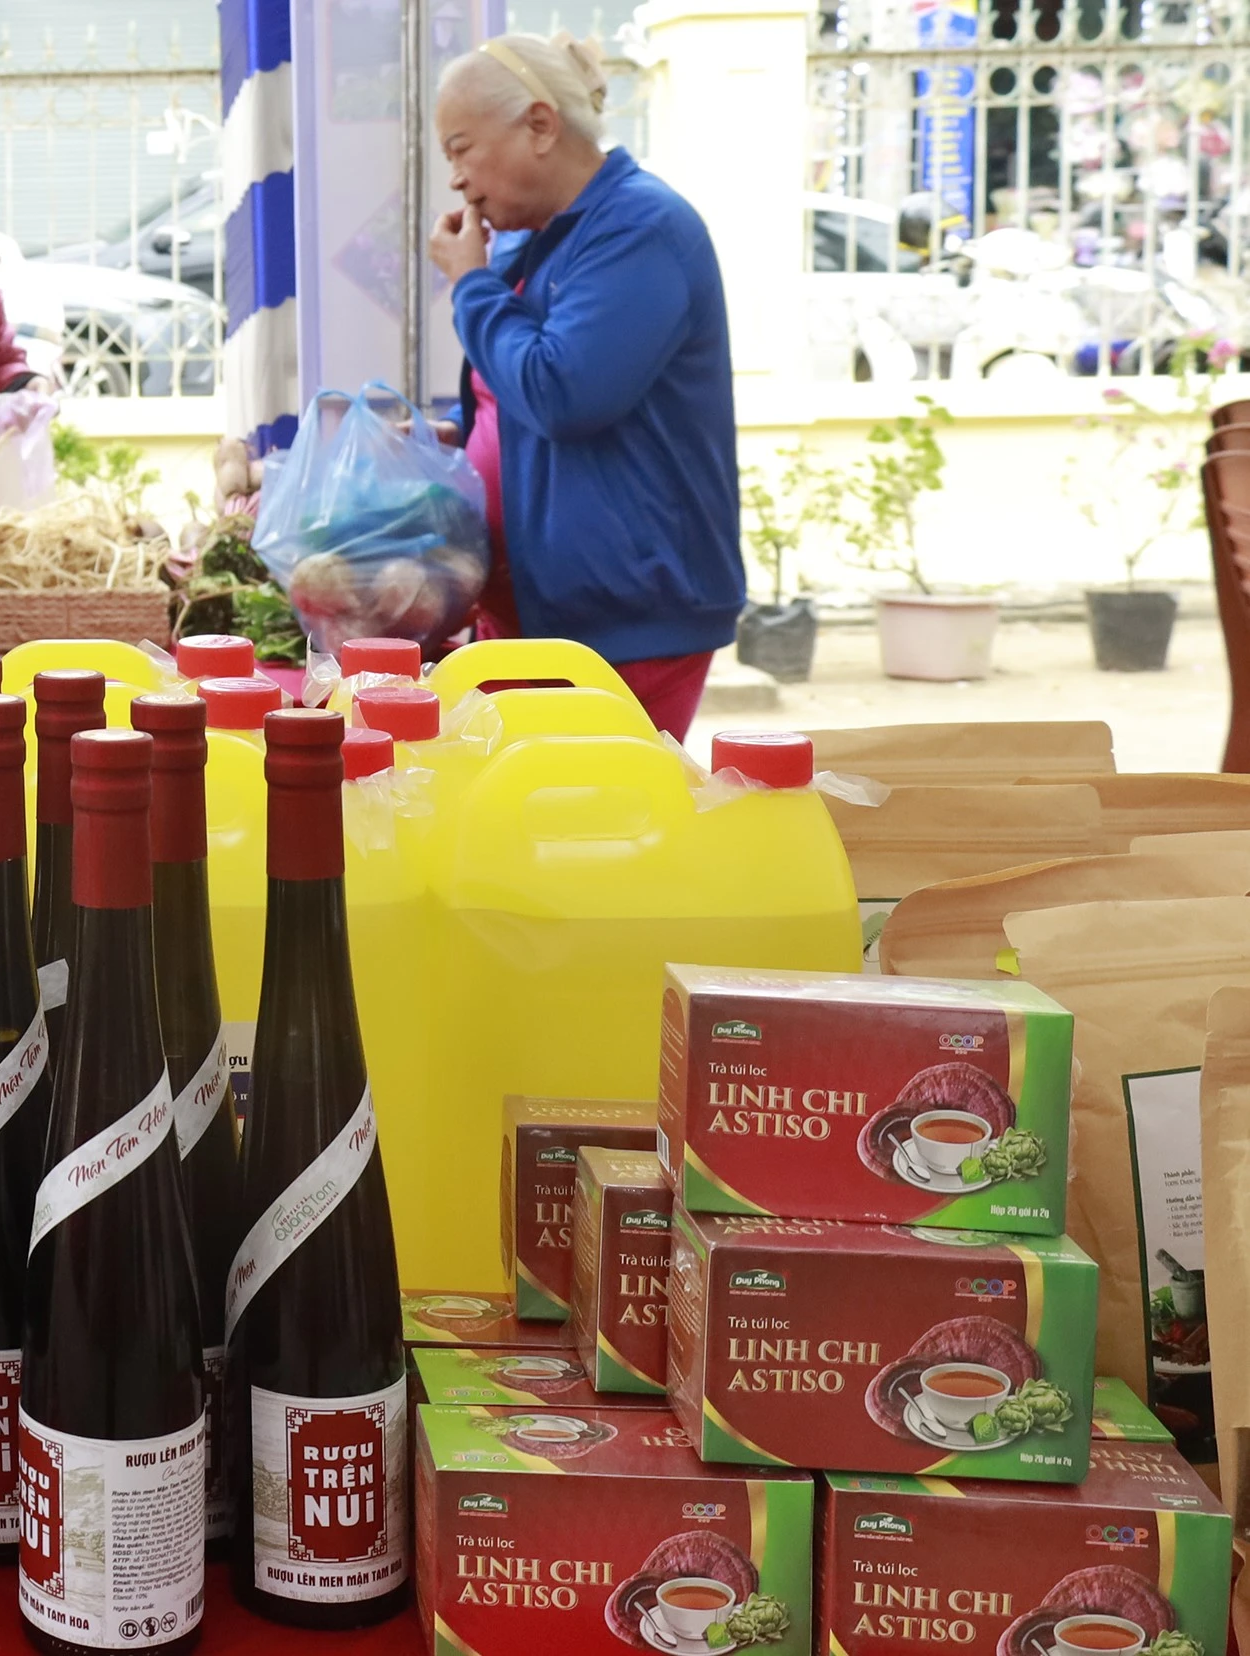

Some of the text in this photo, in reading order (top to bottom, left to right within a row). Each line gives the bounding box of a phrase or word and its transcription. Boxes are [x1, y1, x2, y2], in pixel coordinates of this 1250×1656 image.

[717, 1025, 756, 1037] Duy Phong
[939, 1033, 984, 1049] OCOP
[228, 1055, 248, 1069] ợu
[709, 1062, 767, 1078] Trà túi lọc
[194, 1070, 221, 1106] Mận
[708, 1082, 868, 1116] LINH CHI
[707, 1109, 831, 1141] ASTISO
[68, 1101, 168, 1188] Mận Tam Hoa
[540, 1151, 575, 1163] Duy Phong
[308, 1179, 336, 1206] Tom
[535, 1184, 569, 1196] Trà túi
[990, 1204, 1005, 1216] Hộp
[1007, 1205, 1017, 1215] 20
[1018, 1206, 1031, 1217] gói
[1039, 1208, 1050, 1219] 2g
[625, 1215, 668, 1228] Duy Phong
[723, 1225, 823, 1236] ASTISO
[736, 1276, 780, 1288] Duy Phong
[955, 1277, 1017, 1296] OCOP
[728, 1316, 790, 1331] Trà túi lọc
[728, 1337, 881, 1366] LINH CHI
[727, 1368, 845, 1394] ASTISO
[126, 1452, 156, 1469] RƯỢU
[160, 1446, 177, 1463] LÊN
[303, 1442, 374, 1461] RƯỢU
[304, 1462, 374, 1490] TRÊN
[19, 1476, 50, 1519] RÊN
[463, 1499, 502, 1510] Duy Phong
[682, 1503, 726, 1517] OCOP
[9, 1517, 20, 1529] TA
[860, 1518, 906, 1533] Duy Phong
[456, 1535, 515, 1551] Trà túi lọc
[1086, 1524, 1148, 1544] OCOP
[268, 1566, 294, 1584] RƯỢU
[297, 1568, 317, 1587] LÊN
[320, 1570, 343, 1588] MEN
[346, 1568, 369, 1588] MẬN
[371, 1565, 389, 1583] TAM
[457, 1554, 614, 1586] LINH CHI
[853, 1560, 918, 1577] Trà túi lọc
[458, 1581, 578, 1611] ASTISO
[853, 1582, 1013, 1617] LINH CHI
[30, 1594, 45, 1616] MẬN
[47, 1606, 66, 1625] TAM
[69, 1616, 90, 1631] HOA
[852, 1613, 976, 1644] ASTISO
